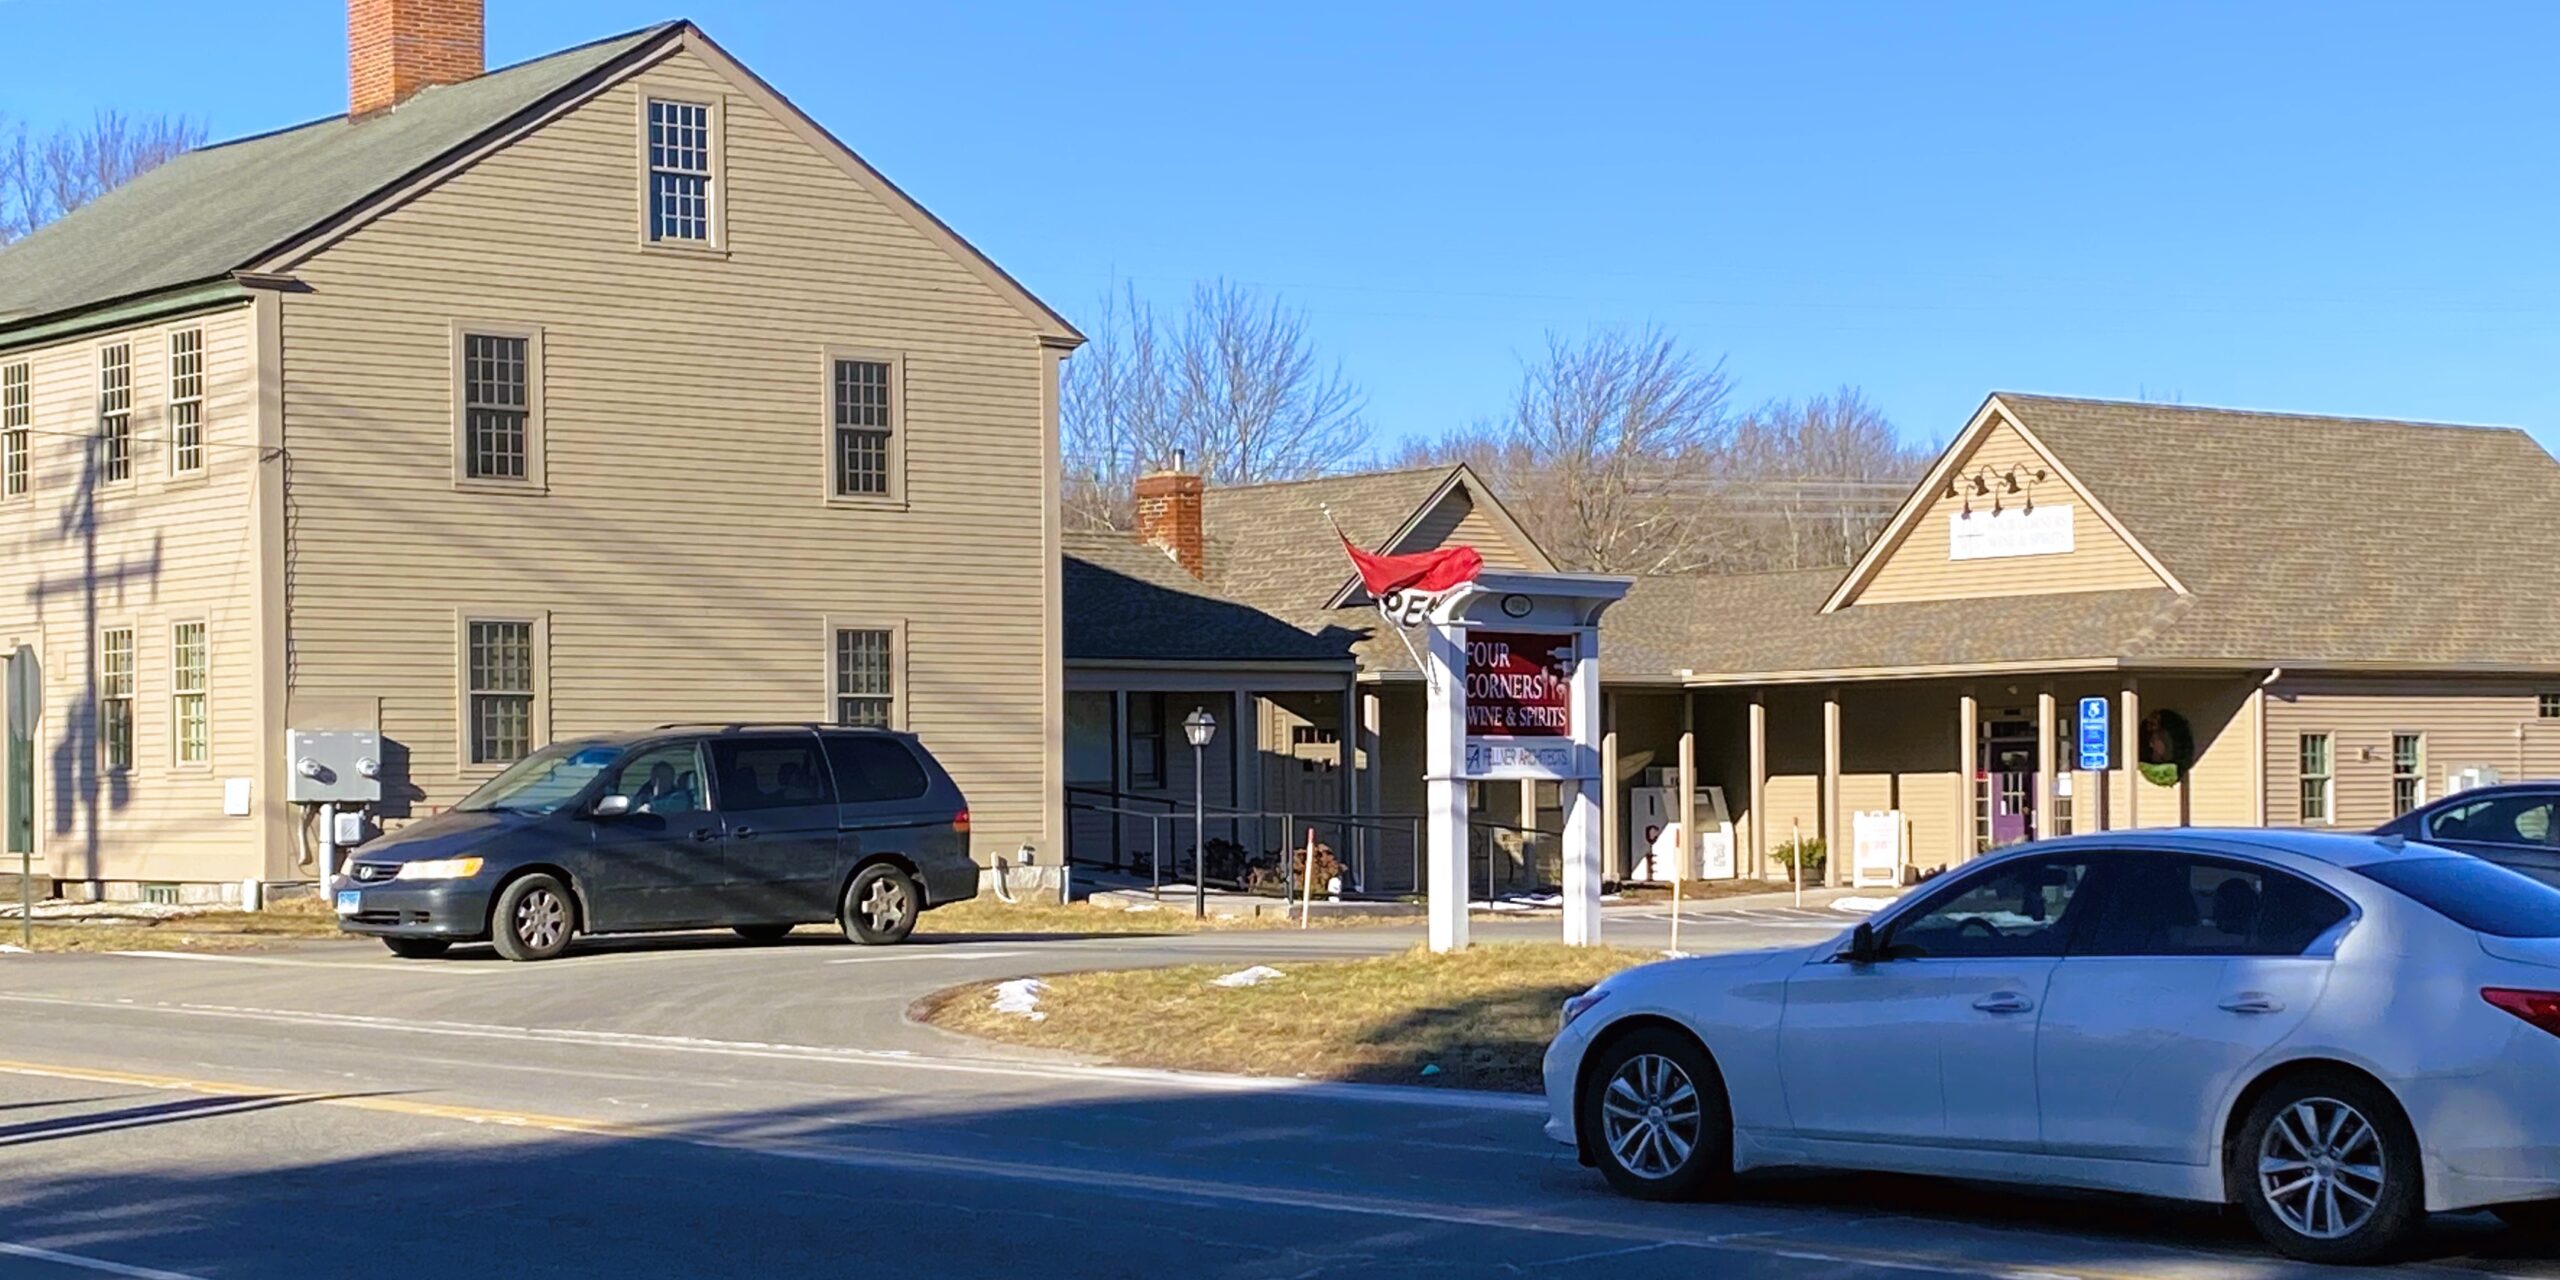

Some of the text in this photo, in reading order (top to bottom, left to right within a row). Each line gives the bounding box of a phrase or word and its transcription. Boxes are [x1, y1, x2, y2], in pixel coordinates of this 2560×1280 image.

[1466, 642, 1511, 668] FOUR
[1466, 673, 1543, 699] CORNERS
[1466, 705, 1566, 727] WINE & SPIRITS
